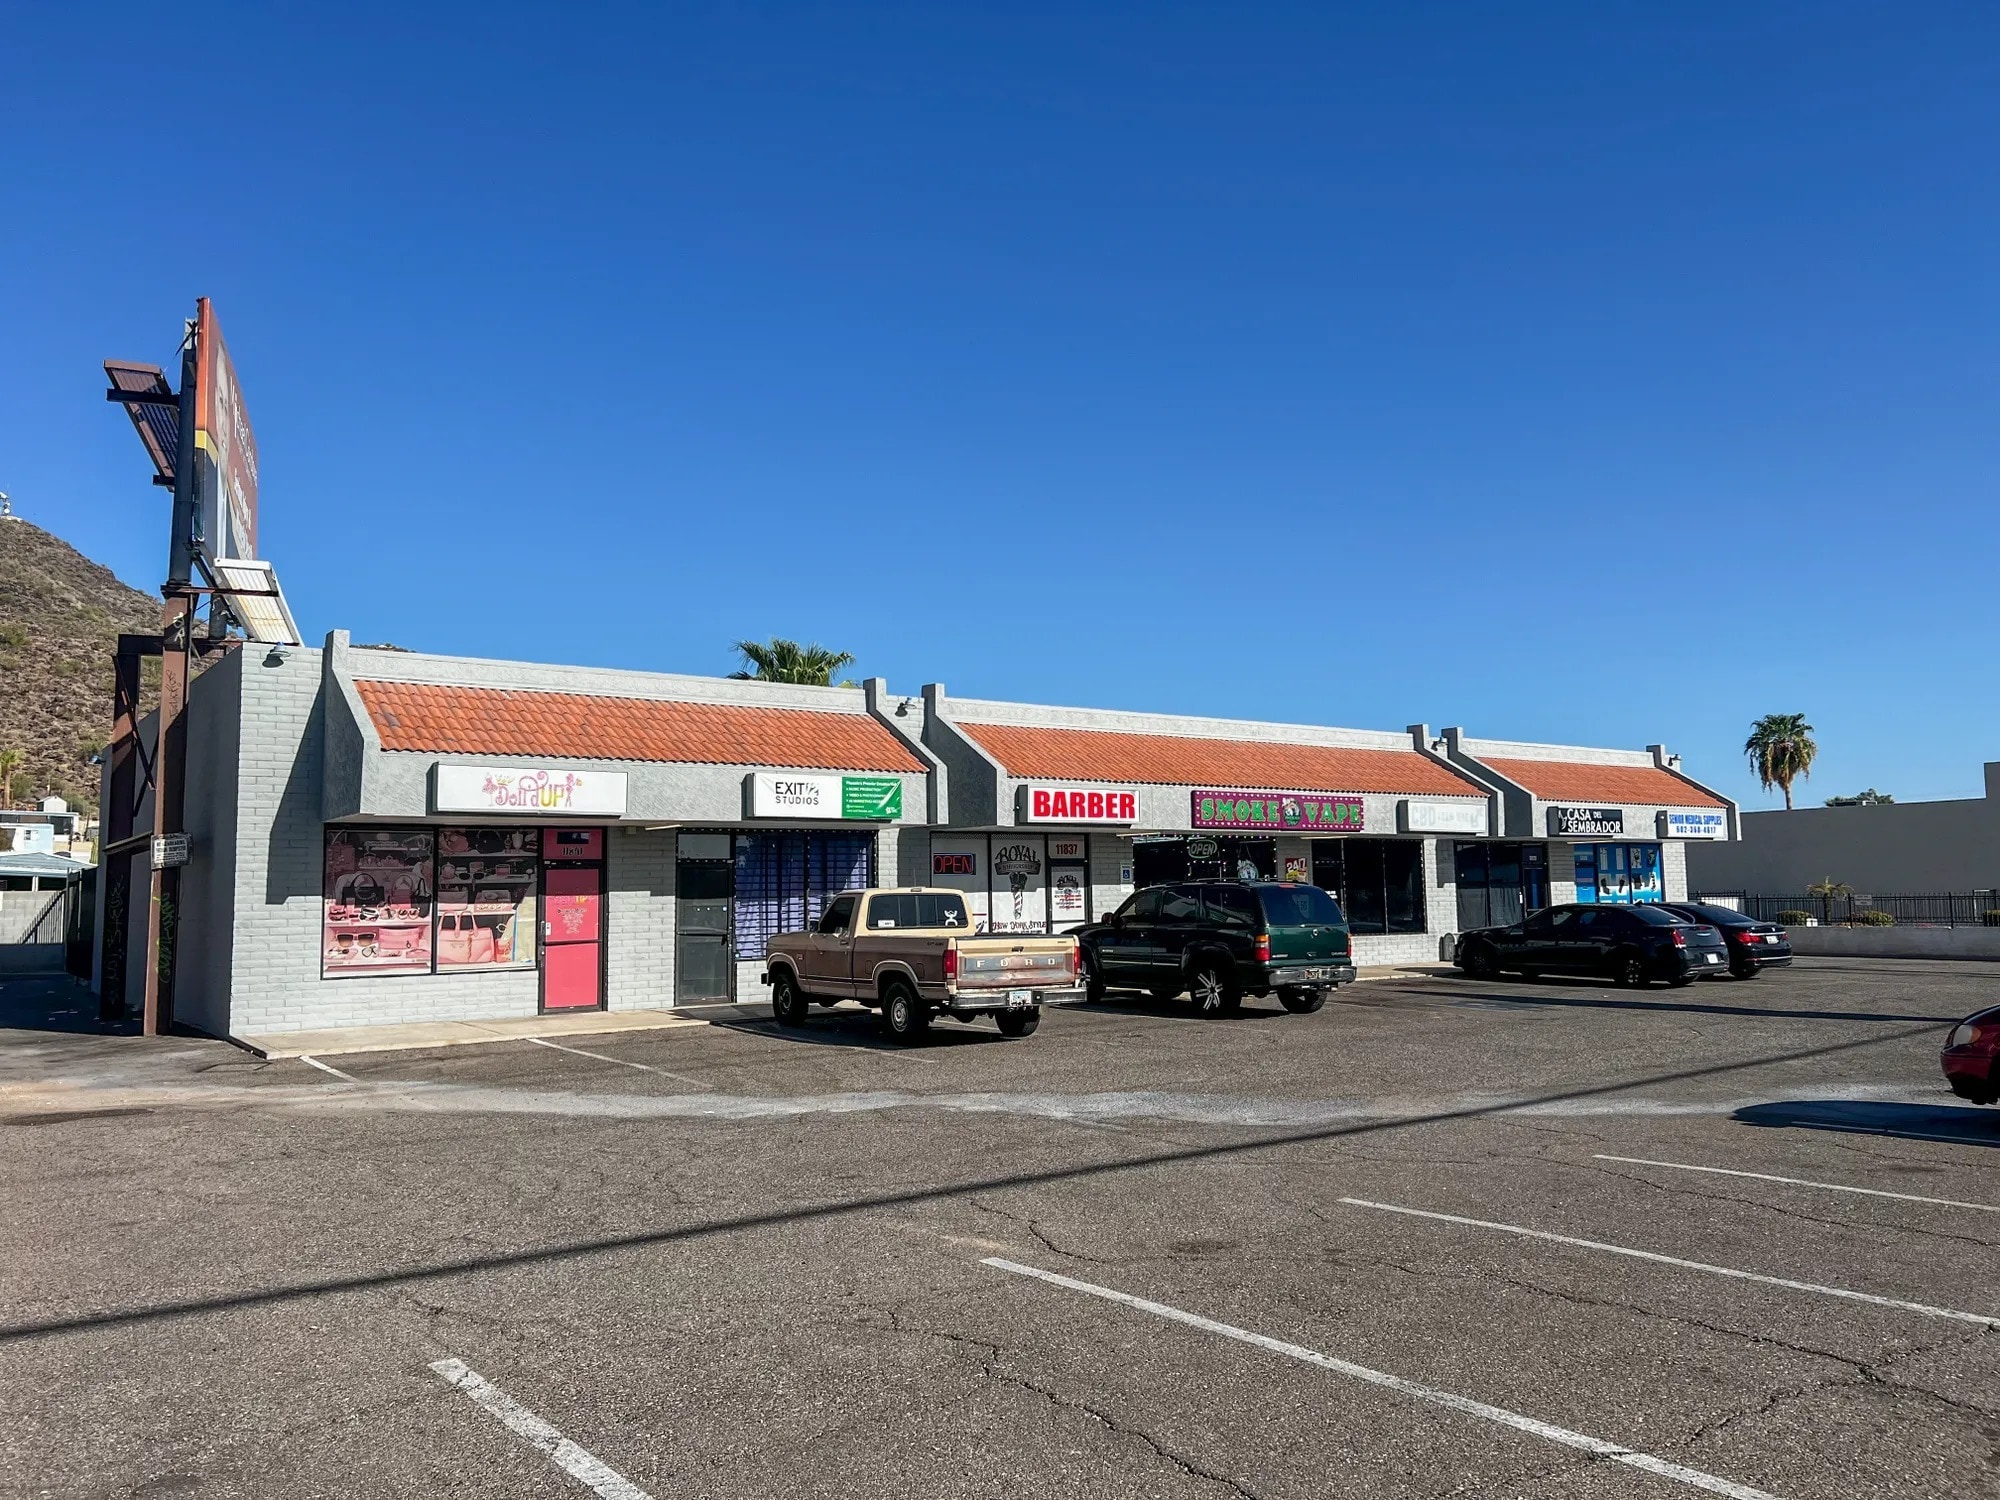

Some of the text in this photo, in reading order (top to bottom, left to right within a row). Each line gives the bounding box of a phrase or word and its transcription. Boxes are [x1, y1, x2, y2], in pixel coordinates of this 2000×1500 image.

[775, 795, 819, 805] STUDIOS
[1033, 790, 1136, 819] BARBER
[1201, 798, 1280, 823] SMOKE
[1304, 802, 1362, 824] VAPE
[1567, 808, 1602, 820] CASA DEL
[1567, 820, 1621, 833] SEMBRADOR
[994, 845, 1041, 863] ROYAL
[1055, 844, 1078, 855] 11837
[1190, 843, 1215, 855] OPEN
[933, 855, 973, 875] OPEN
[976, 957, 1055, 968] FORD
